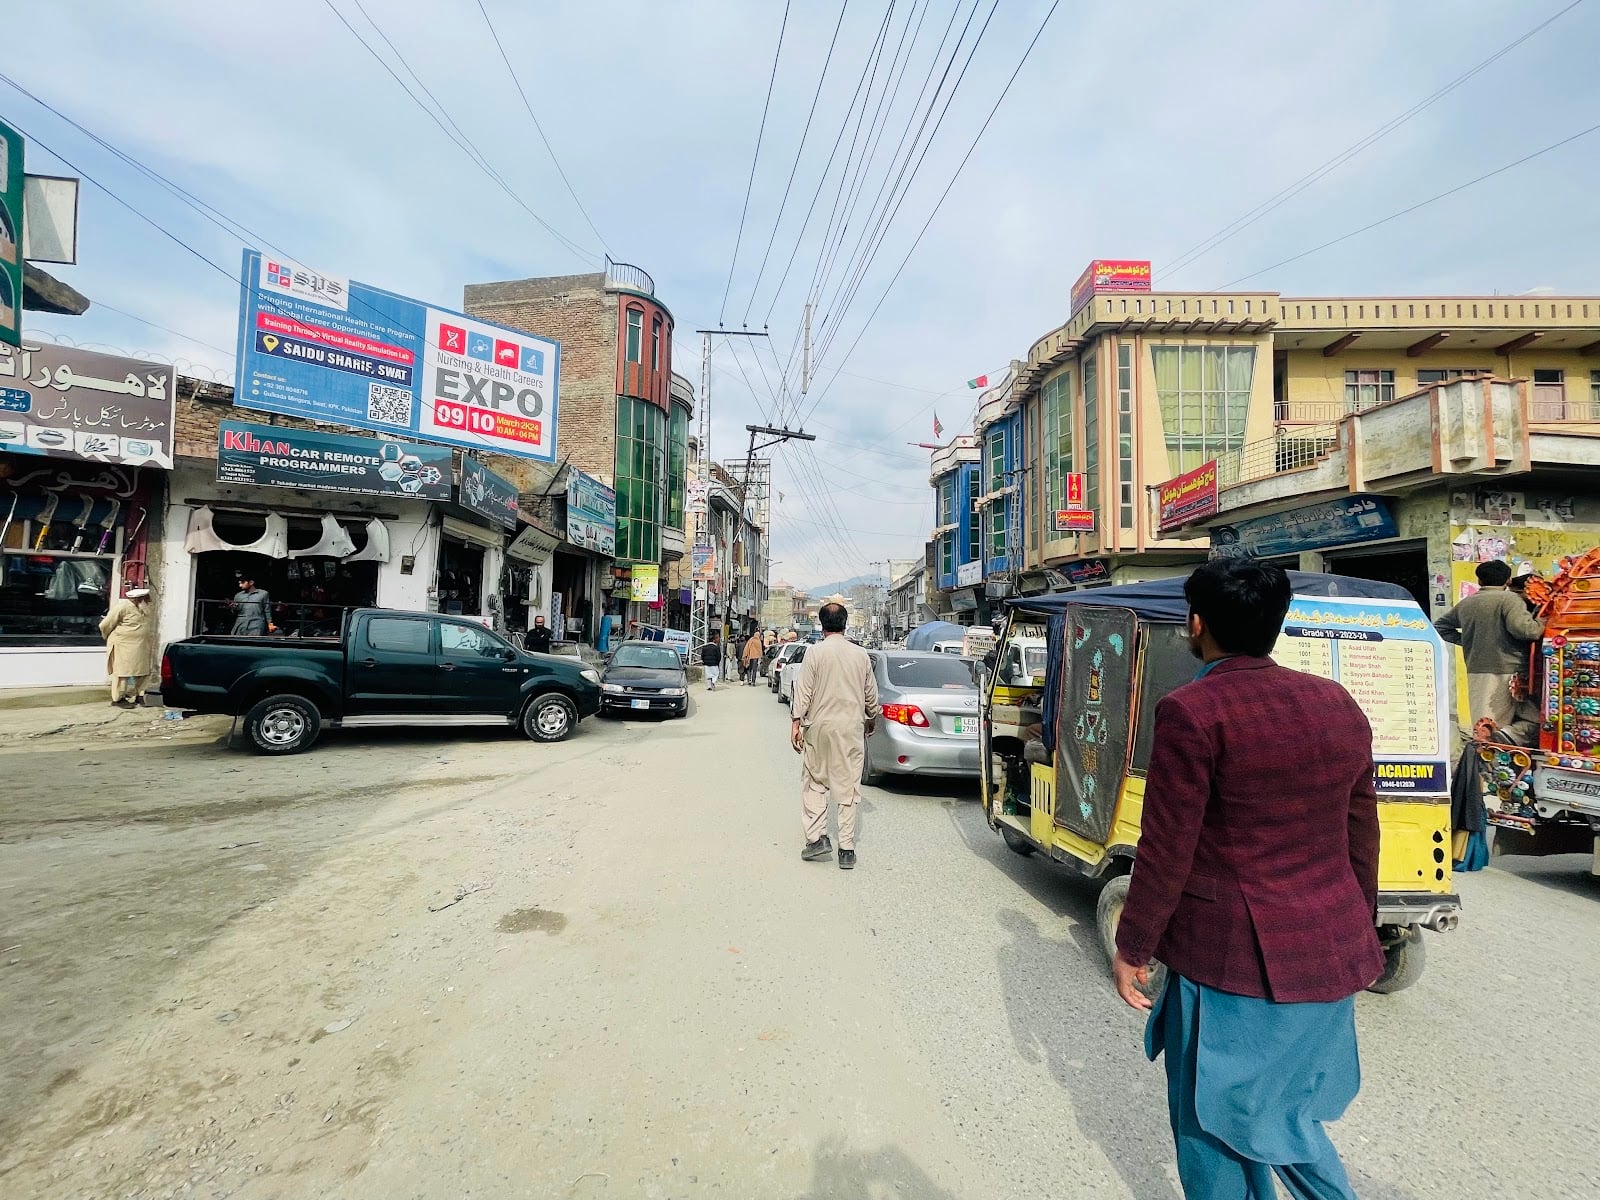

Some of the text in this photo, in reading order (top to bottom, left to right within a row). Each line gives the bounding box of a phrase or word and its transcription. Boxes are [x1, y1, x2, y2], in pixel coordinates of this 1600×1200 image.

[258, 293, 292, 309] Bringing
[295, 303, 343, 321] International
[345, 316, 368, 327] Health
[369, 323, 386, 333] Care
[387, 327, 415, 341] Program
[258, 303, 380, 340] with Global Career Opportunities
[264, 318, 409, 360] Training Through Virtual Reality Simulation Lab
[284, 342, 324, 361] SAIDU
[378, 365, 408, 380] SWAT
[437, 352, 544, 388] Nursing & Health Careers
[435, 367, 543, 418] EXPO
[437, 405, 538, 432] 09 10 March 2K24
[496, 426, 503, 434] 10
[504, 427, 515, 436] AM
[519, 430, 527, 438] 04
[528, 432, 538, 441] PM
[259, 456, 367, 475] PROGRAMMERS
[290, 448, 320, 460] CAR
[324, 451, 380, 466] REMOTE
[1345, 499, 1376, 517] حاجی
[1301, 628, 1324, 637] Grade
[1325, 630, 1335, 638] 10
[1340, 631, 1368, 640] 2023-24
[1377, 764, 1435, 778] ACADEMY
[1546, 777, 1600, 797] SUZUK
